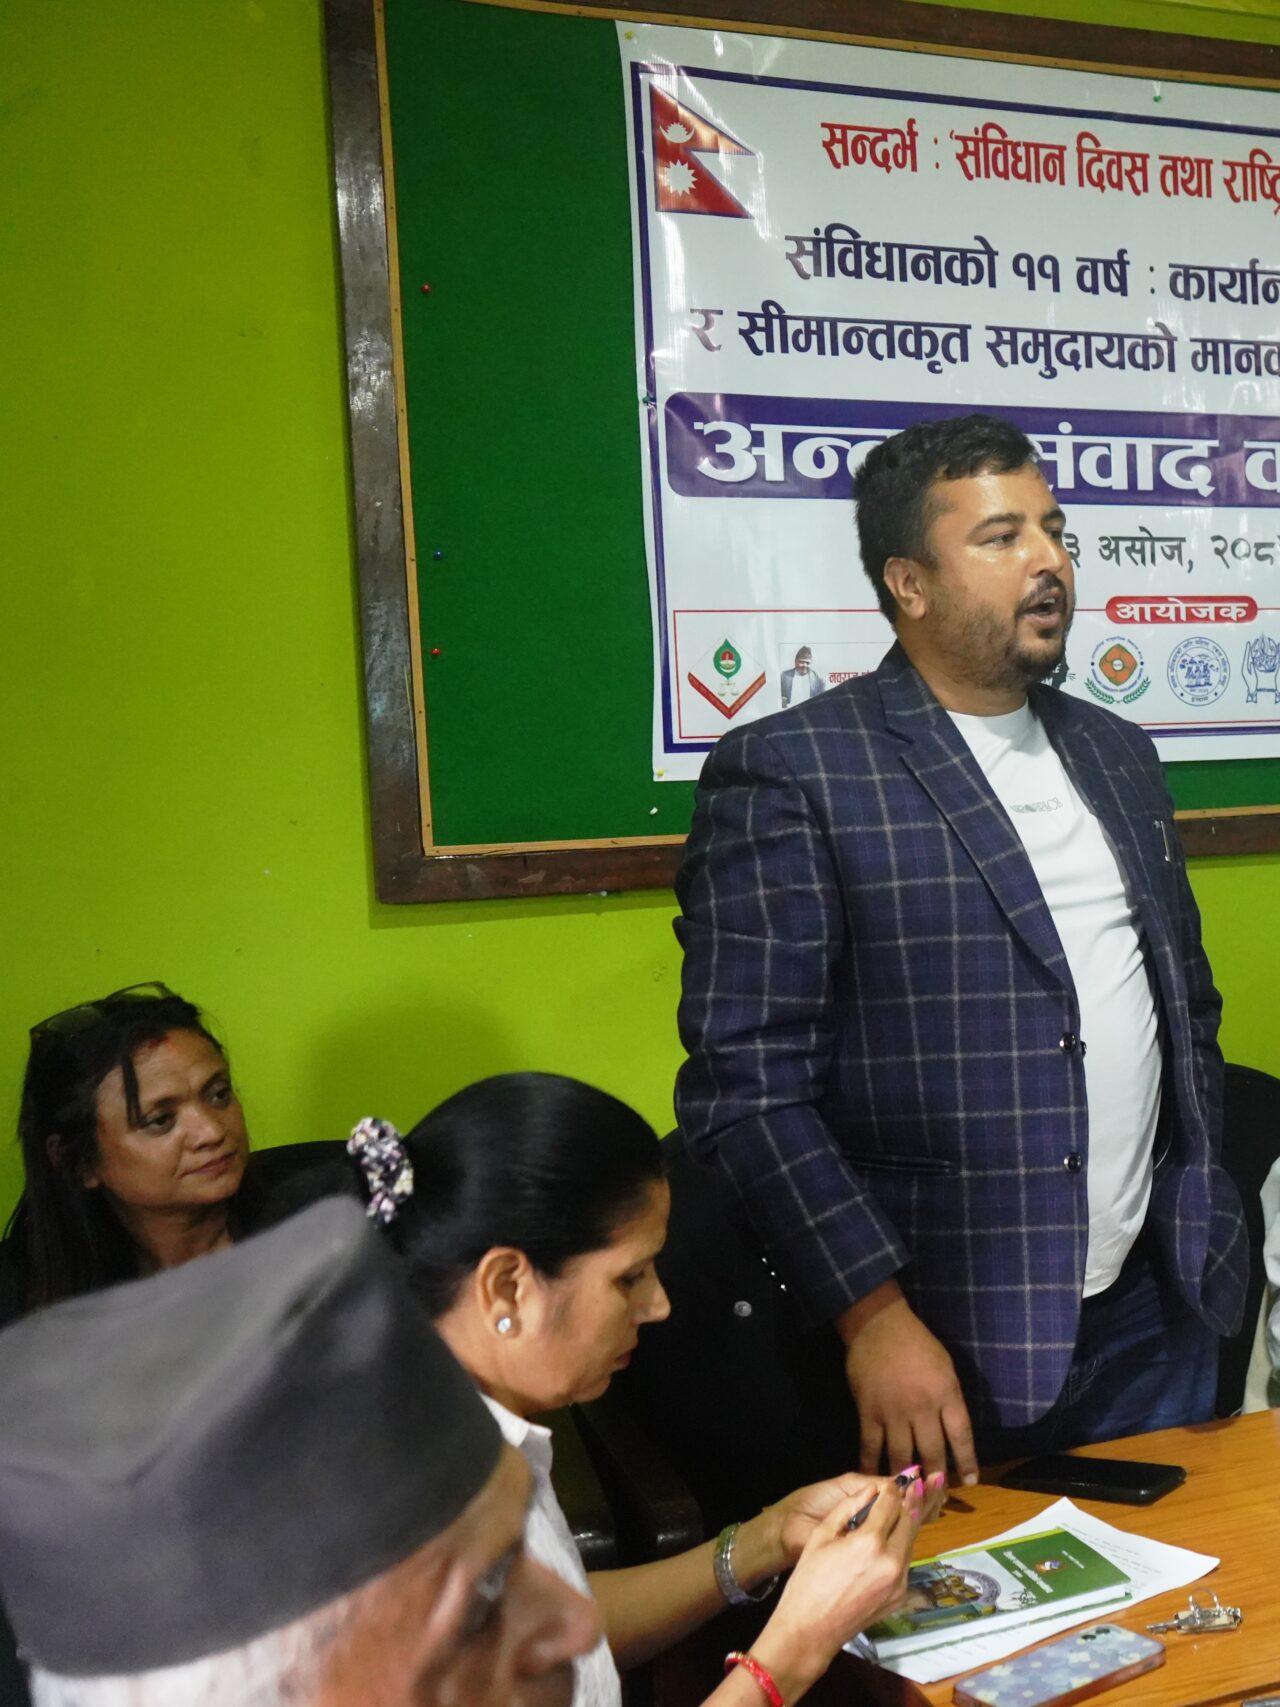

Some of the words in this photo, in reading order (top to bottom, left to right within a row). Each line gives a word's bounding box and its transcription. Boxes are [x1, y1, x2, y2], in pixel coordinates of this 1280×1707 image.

[821, 118, 918, 174] सन्दर्भ
[1076, 131, 1150, 195] दिवस
[1159, 153, 1214, 199] तथा
[785, 223, 999, 288] संविधानको
[1012, 253, 1060, 293] ११
[1076, 248, 1131, 298] वर्ष
[690, 309, 723, 352] र
[737, 300, 972, 374] सीमान्तकृत
[985, 322, 1178, 379] समुदायको
[1098, 526, 1194, 573] असोज,
[1116, 597, 1249, 622] आयोजक
